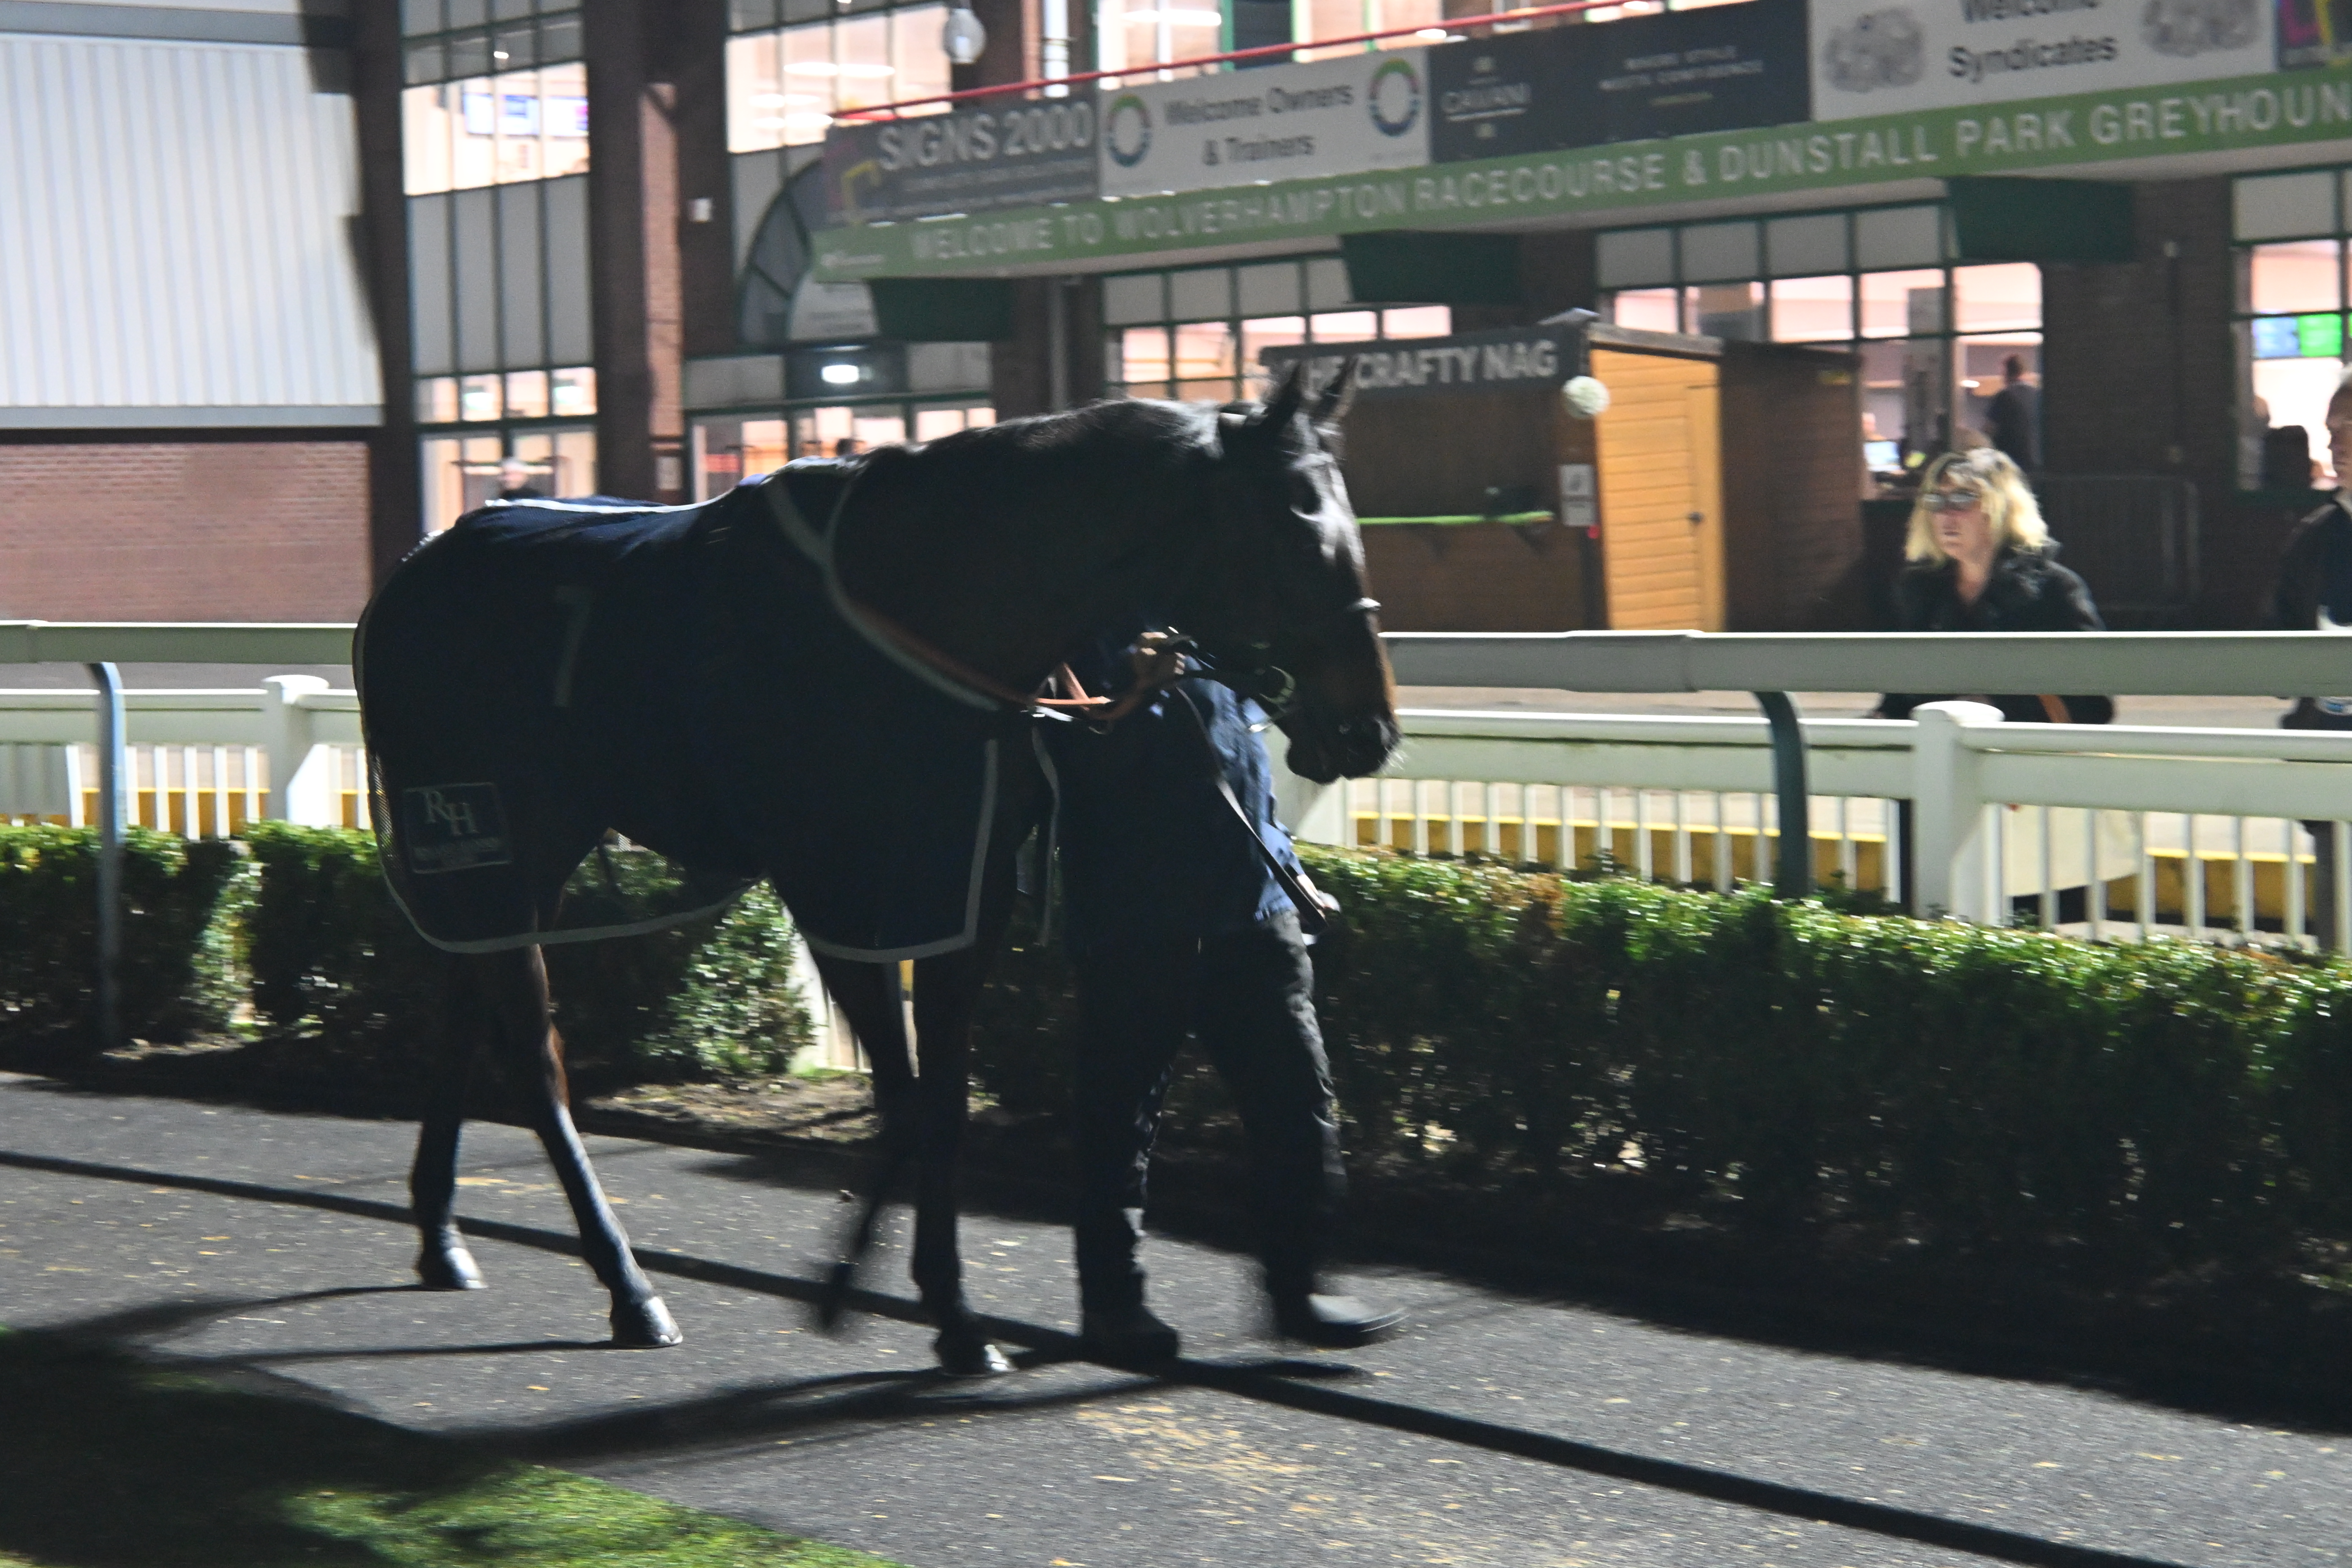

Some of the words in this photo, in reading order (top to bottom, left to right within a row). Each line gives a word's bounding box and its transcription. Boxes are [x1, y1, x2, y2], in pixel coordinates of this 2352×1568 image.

[1948, 37, 2118, 83] Syndicates
[1165, 97, 1262, 125] Welcome
[1270, 85, 1353, 113] Owners
[879, 114, 998, 170] SIGNS
[1003, 101, 1094, 156] 2000
[1203, 139, 1219, 166] &
[1226, 135, 1315, 162] Trainers
[912, 217, 1053, 259] WELCOME
[1063, 212, 1105, 249] TO
[1114, 181, 1404, 239] WOLVERHAMPTON
[1414, 152, 1667, 211] RACECOURSE
[1682, 150, 1707, 186] &
[1718, 125, 1939, 182] DUNSTALL
[1956, 109, 2076, 158] PARK
[2088, 83, 2352, 145] GREYHOUN
[1356, 346, 1481, 389] CRAFTY
[1481, 340, 1559, 381] NAG
[423, 790, 480, 836] RH
